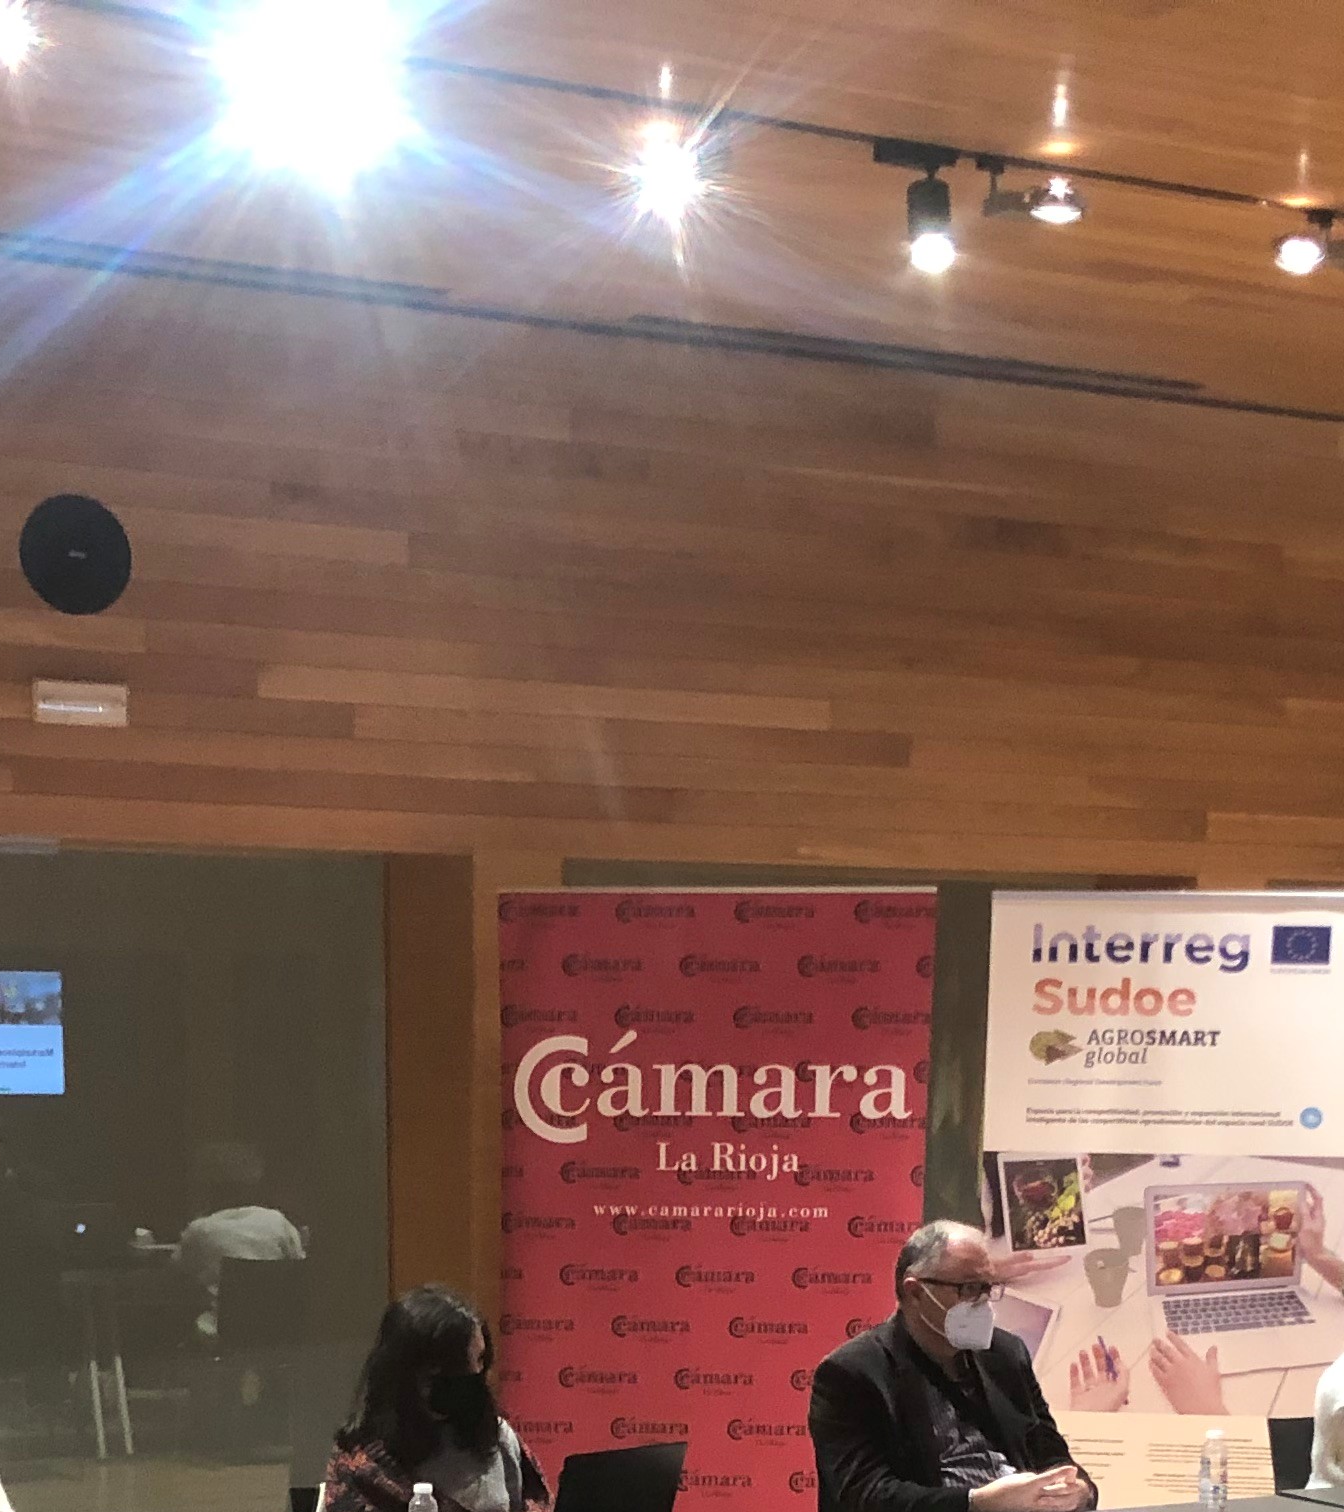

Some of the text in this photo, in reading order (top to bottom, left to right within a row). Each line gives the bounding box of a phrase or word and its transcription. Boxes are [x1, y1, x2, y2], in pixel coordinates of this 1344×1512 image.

[1031, 922, 1251, 974] Interreg
[1032, 977, 1197, 1017] Sudoe
[1086, 1028, 1222, 1048] AGROSMART
[1084, 1045, 1150, 1068] global
[656, 1141, 799, 1181] La Rioja
[593, 1204, 829, 1222] www.camararioja.com
